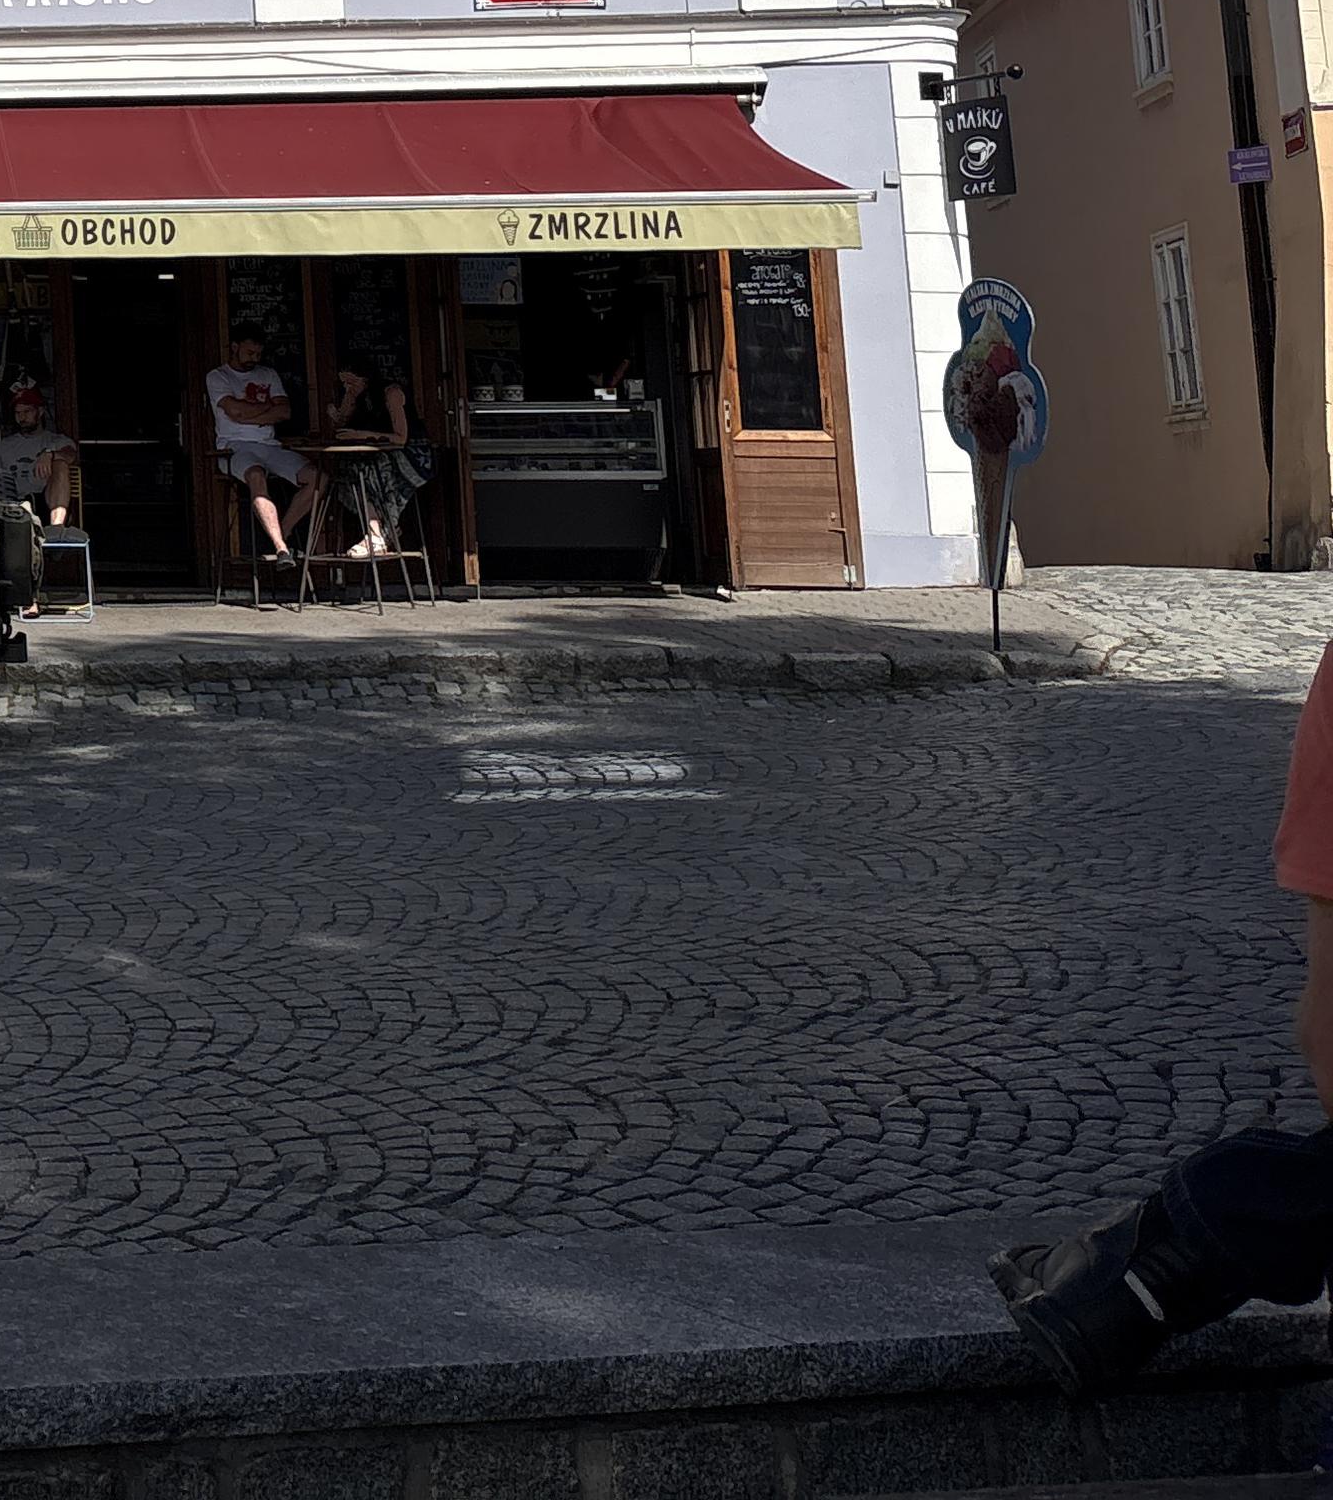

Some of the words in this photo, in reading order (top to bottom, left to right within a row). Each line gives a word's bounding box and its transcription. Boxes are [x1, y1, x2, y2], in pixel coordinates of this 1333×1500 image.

[945, 118, 954, 133] U
[956, 106, 1003, 131] MAŠKŮ
[963, 178, 996, 195] CAFÉ
[61, 217, 176, 245] OBCHOD
[528, 210, 683, 240] ZMRZLINA
